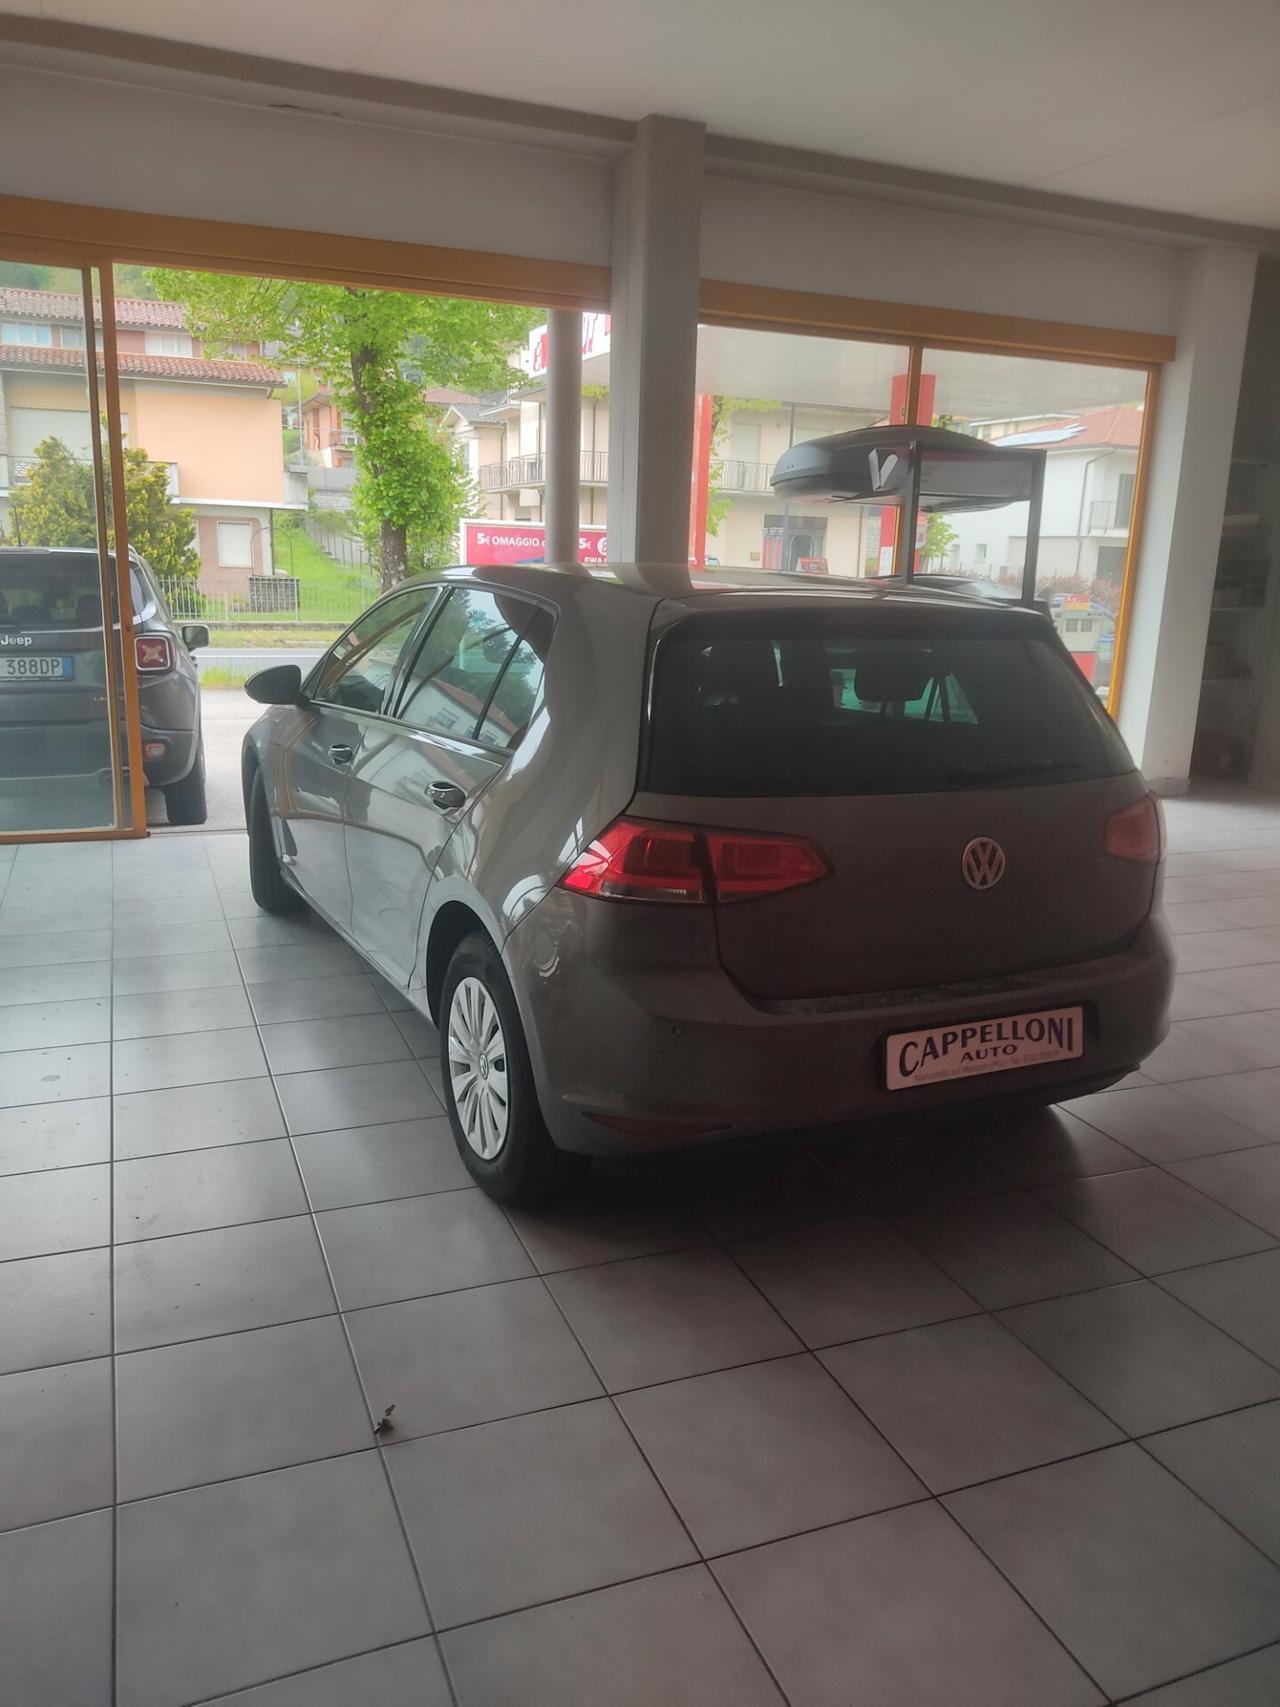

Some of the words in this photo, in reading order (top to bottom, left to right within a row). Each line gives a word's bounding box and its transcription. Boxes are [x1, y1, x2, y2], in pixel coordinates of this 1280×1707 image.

[492, 536, 540, 547] OMAGGIO
[1, 635, 32, 647] Jeep
[7, 659, 60, 675] 388DP
[898, 1017, 1075, 1078] CAPPELLONI
[960, 1043, 1019, 1064] AUTO
